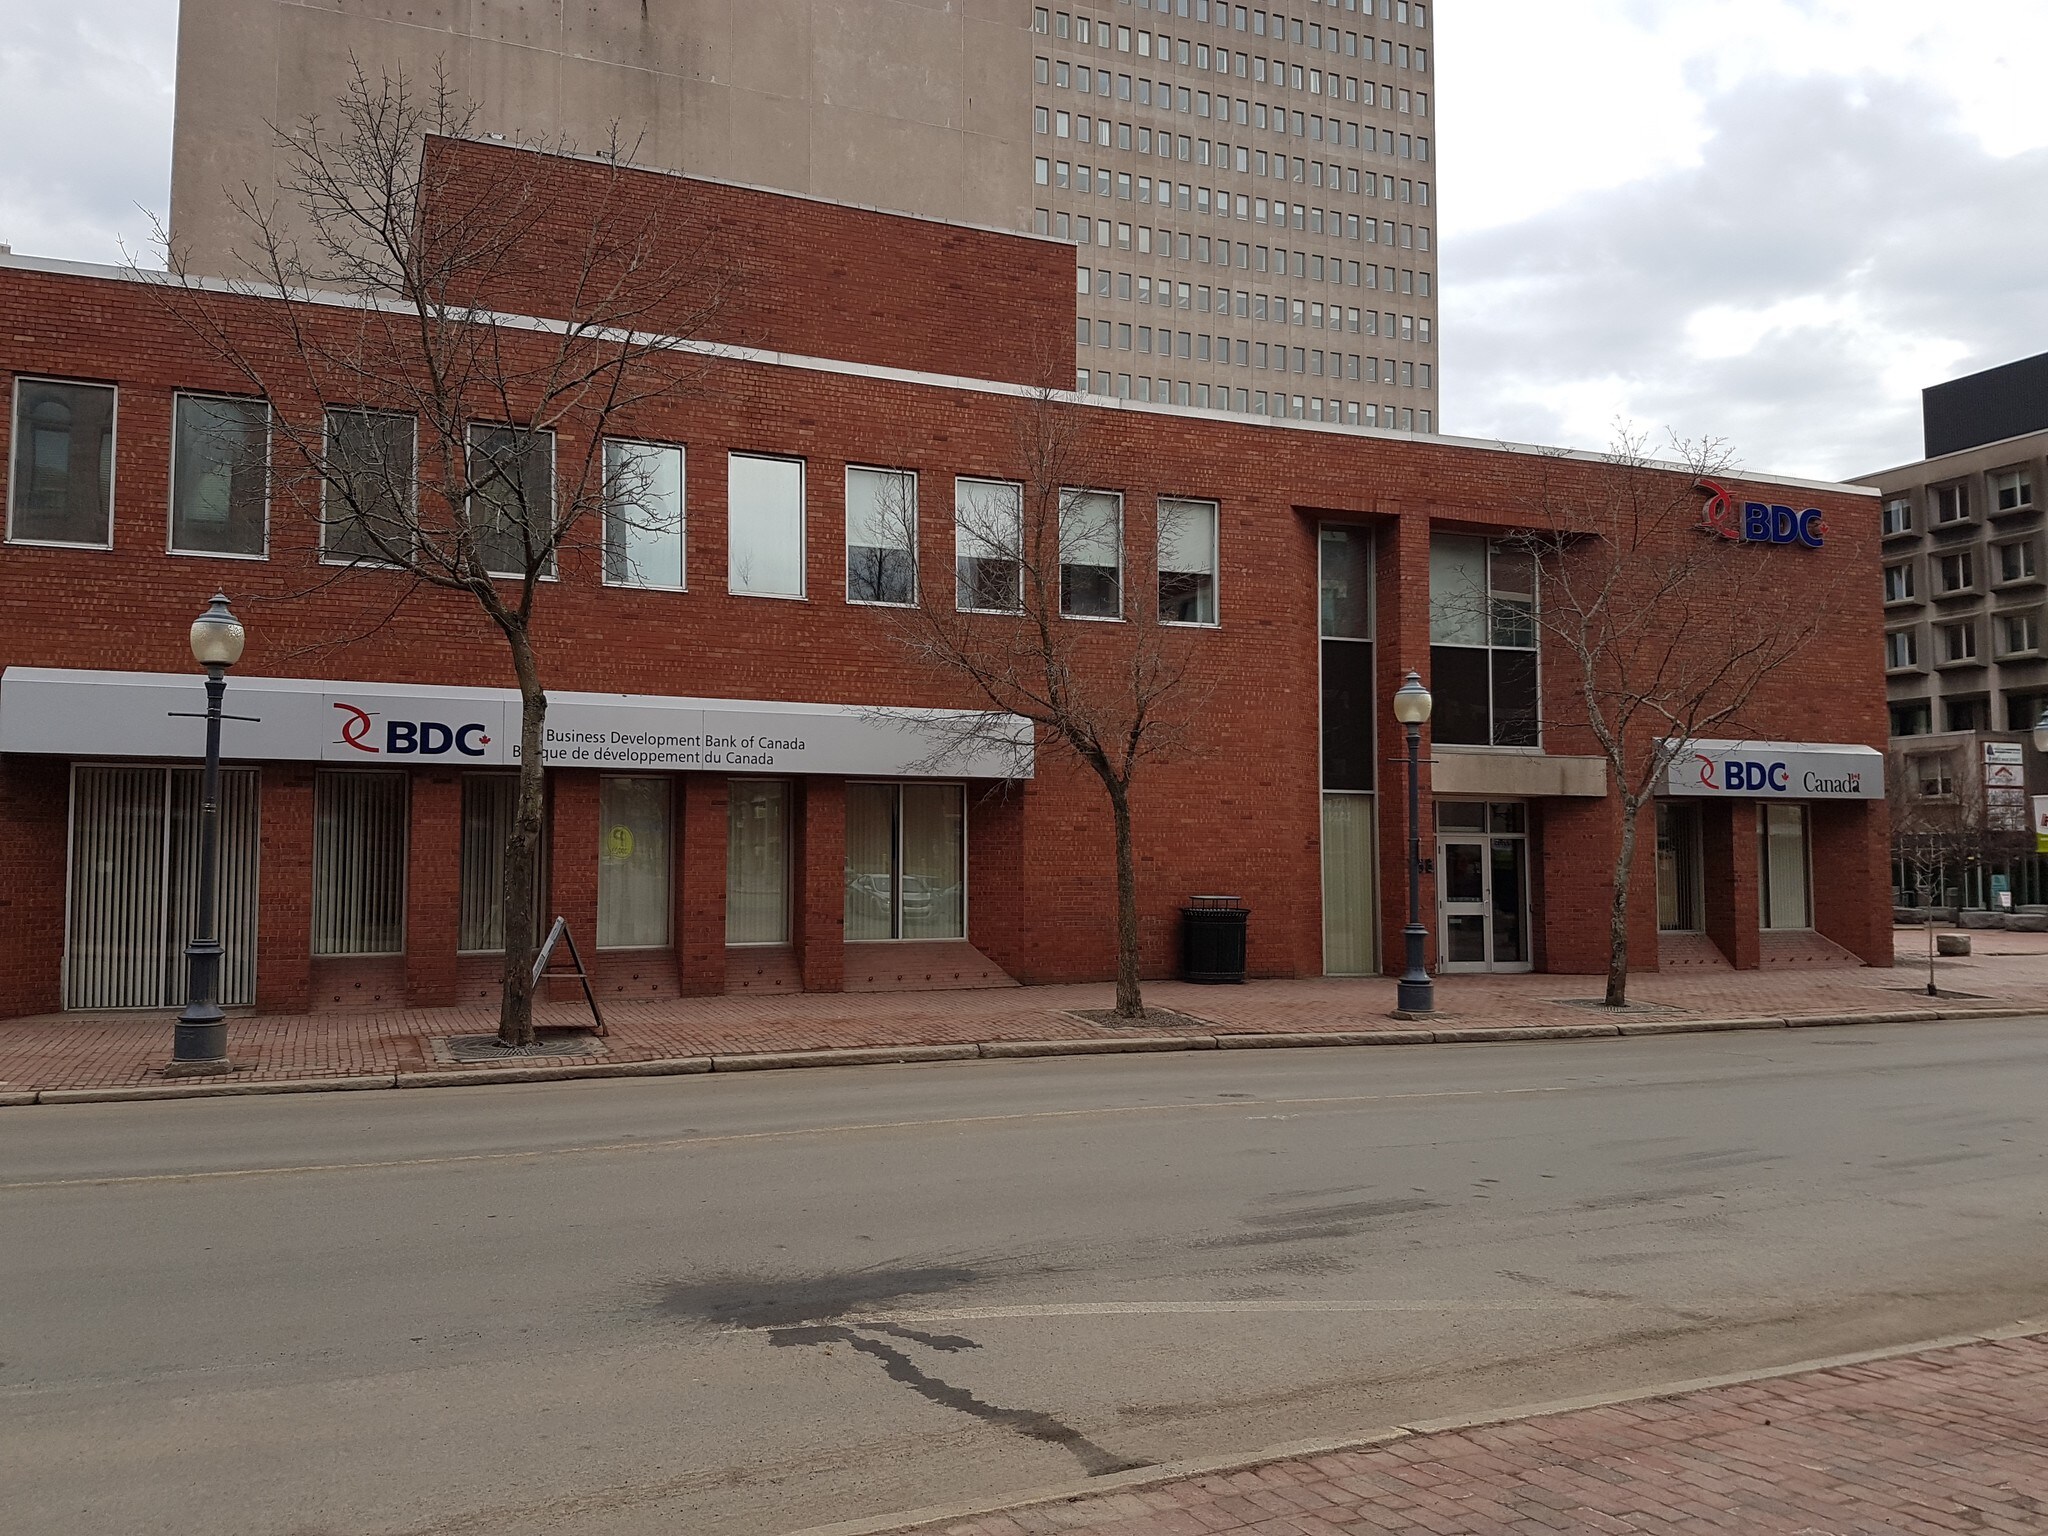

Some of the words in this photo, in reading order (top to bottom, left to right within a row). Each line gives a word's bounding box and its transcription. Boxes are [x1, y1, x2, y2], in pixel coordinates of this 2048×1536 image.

[1743, 502, 1824, 547] BDC
[386, 720, 486, 756] BDC
[546, 729, 606, 743] Business
[611, 731, 700, 748] Development
[705, 735, 737, 747] Bank
[741, 735, 755, 748] of
[758, 737, 806, 750] Canada
[512, 745, 567, 762] Bque
[572, 747, 590, 760] de
[594, 747, 700, 765] développement
[704, 751, 722, 764] du
[725, 752, 774, 765] Canada
[1725, 761, 1787, 791] BDC
[1803, 771, 1861, 793] Canada
